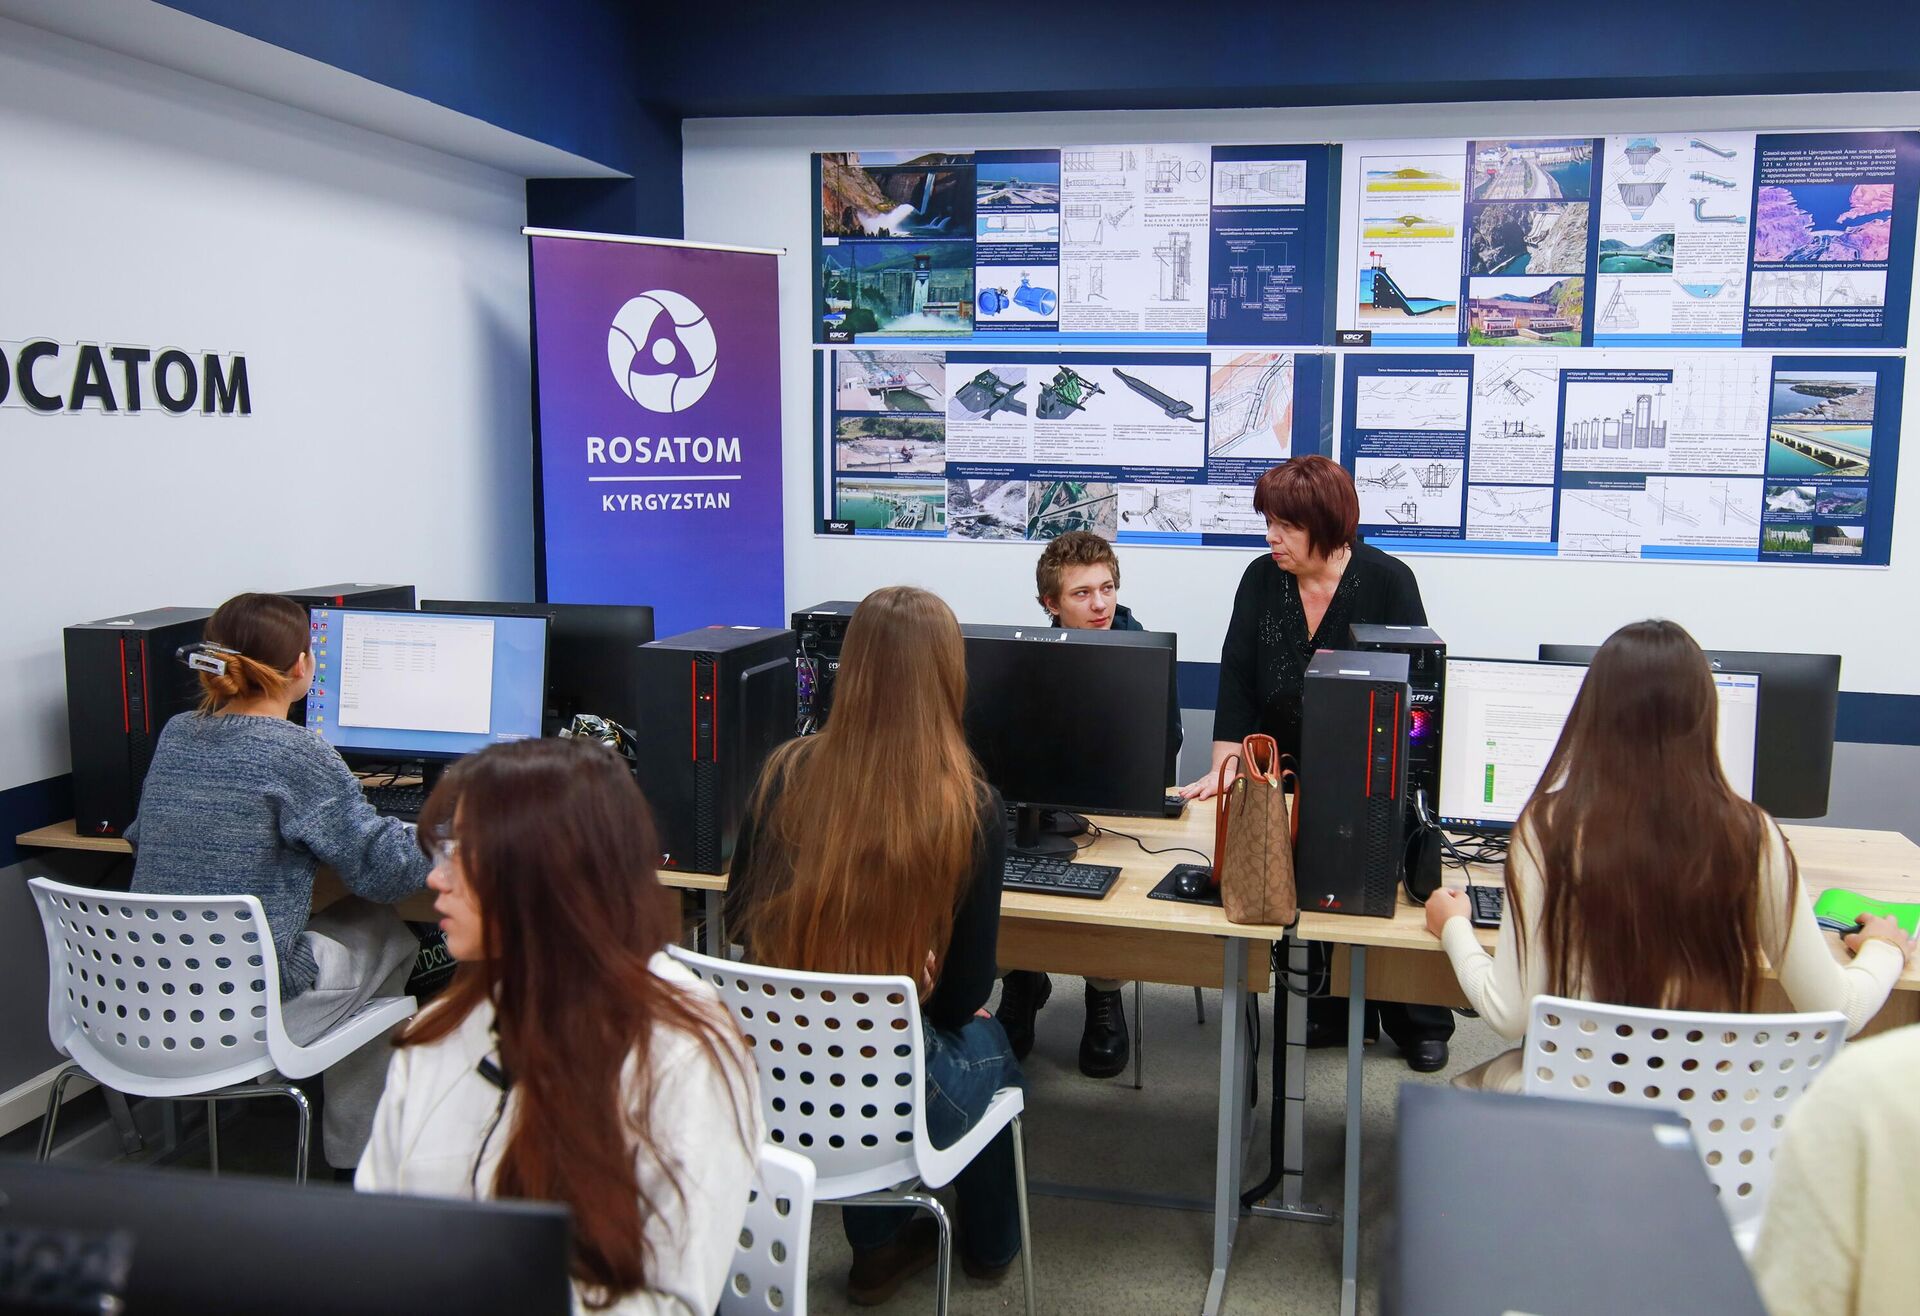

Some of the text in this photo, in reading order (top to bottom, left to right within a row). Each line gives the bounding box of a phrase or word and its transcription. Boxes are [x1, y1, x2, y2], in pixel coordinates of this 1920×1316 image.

[0, 341, 251, 413] САТОМ
[587, 436, 741, 464] ROSATOM
[602, 493, 731, 511] KYRGYZSTAN
